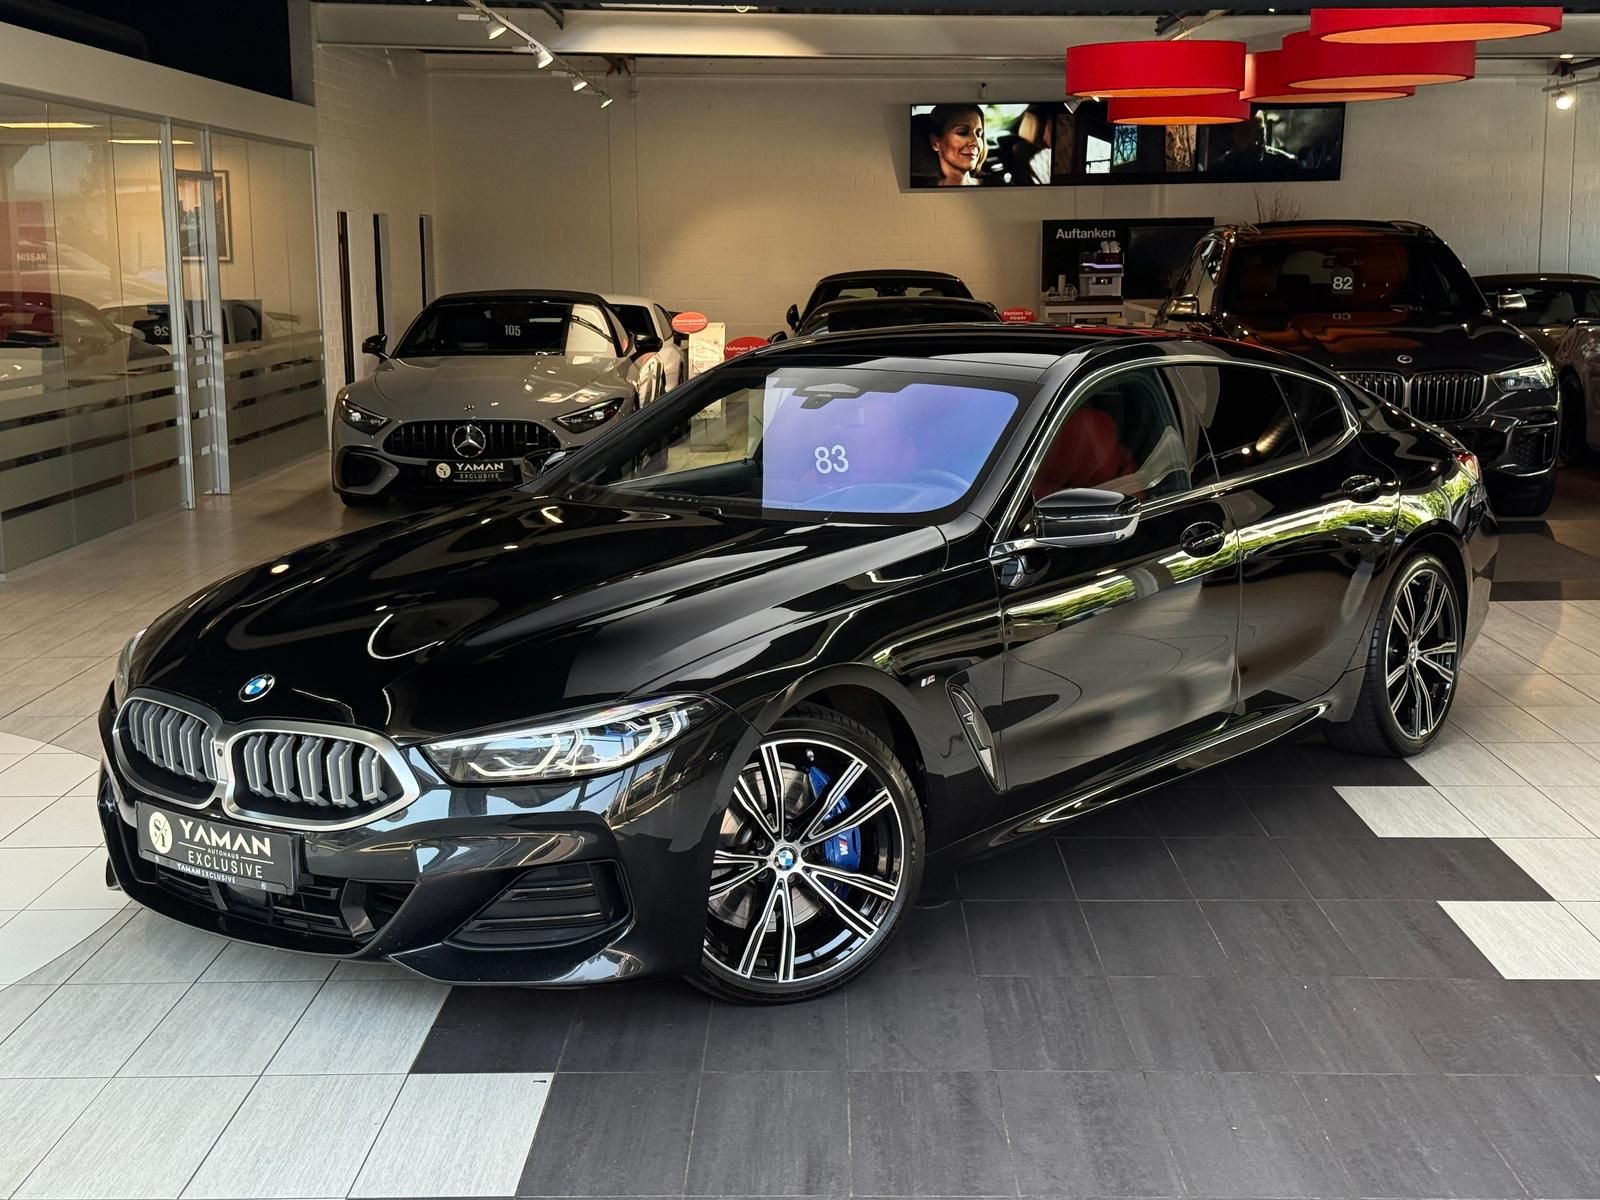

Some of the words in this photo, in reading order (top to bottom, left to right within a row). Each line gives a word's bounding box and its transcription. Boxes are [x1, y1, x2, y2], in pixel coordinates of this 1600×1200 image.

[1056, 227, 1116, 240] Auftanken
[1332, 276, 1353, 290] 82
[504, 324, 521, 336] 105
[814, 444, 849, 474] 83
[455, 462, 504, 471] YAMAN
[179, 818, 272, 857] YAMAN
[207, 847, 240, 860] AUTOHAUS
[188, 850, 263, 879] EXCLUSIVE
[176, 862, 201, 875] YAMAN
[201, 869, 236, 884] EXCLUSIVE
